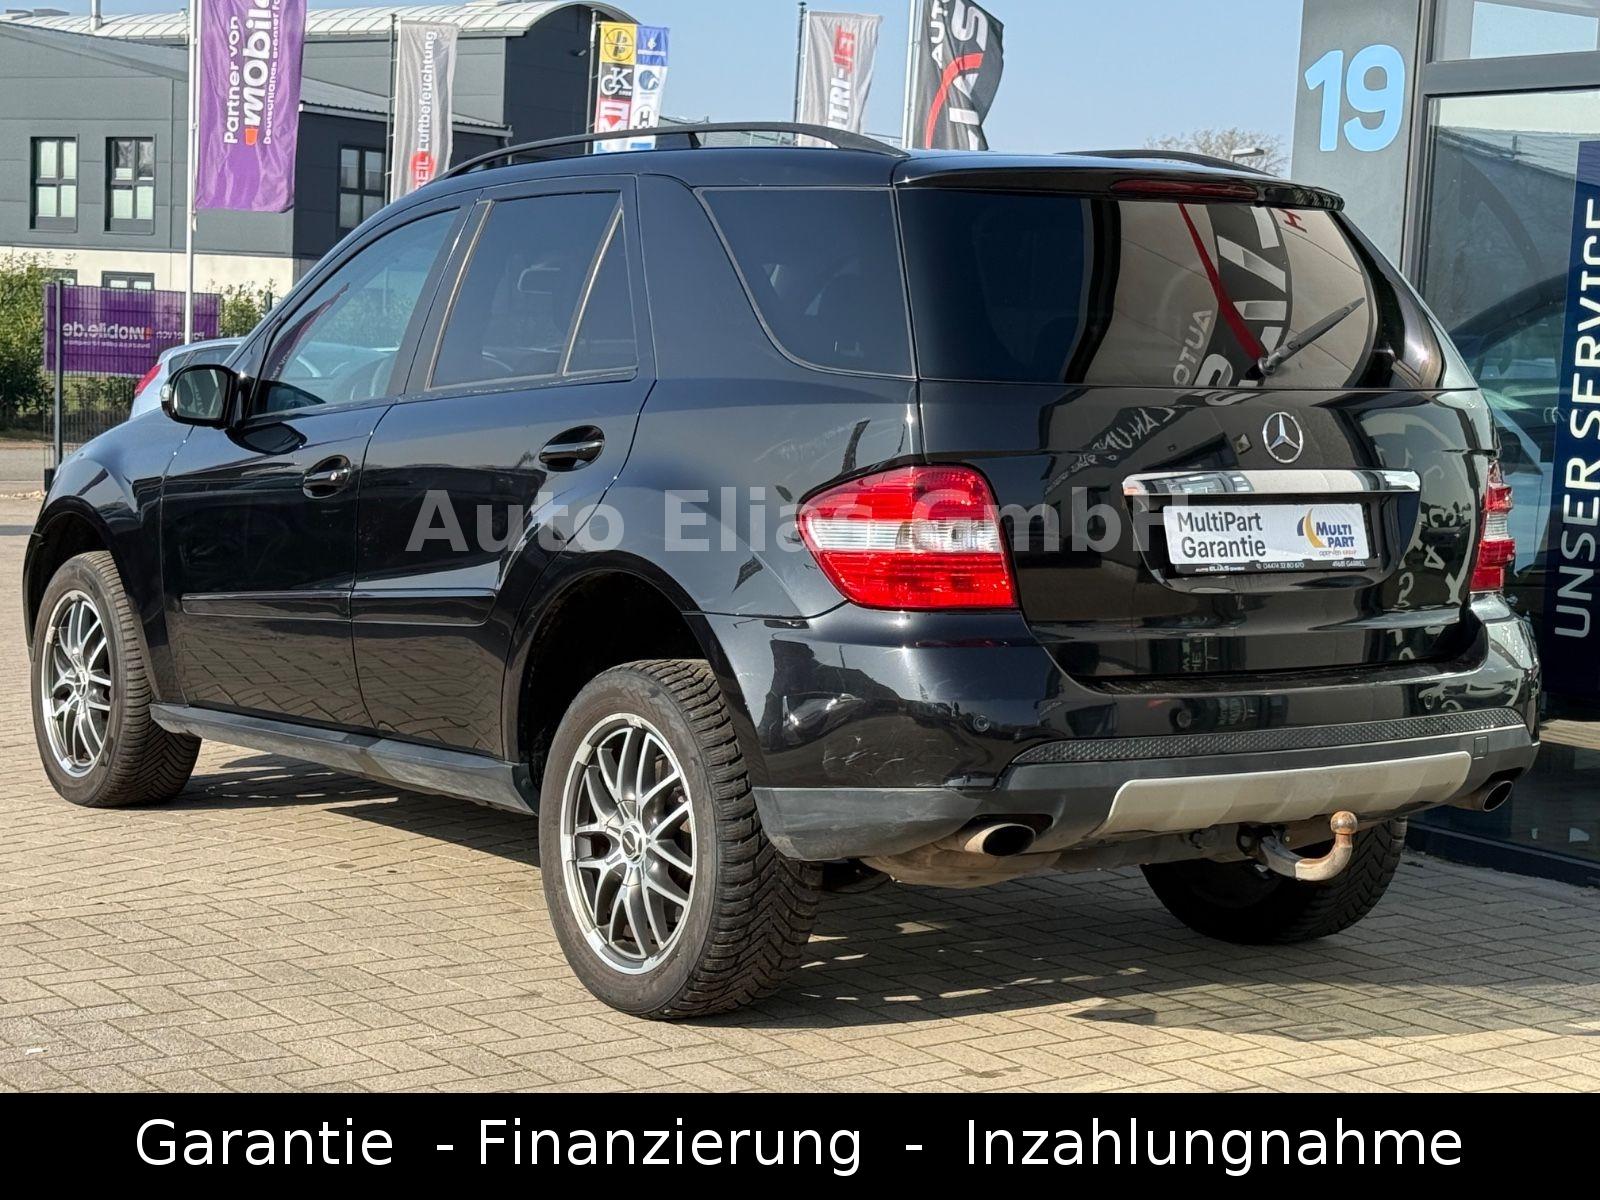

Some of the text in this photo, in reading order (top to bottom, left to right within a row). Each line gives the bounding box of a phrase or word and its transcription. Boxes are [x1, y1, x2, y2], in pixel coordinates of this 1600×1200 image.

[930, 0, 950, 70] AUT
[224, 16, 240, 144] Partner von
[416, 31, 438, 152] Luftbefeuchtung
[1304, 44, 1406, 152] 19
[1177, 511, 1263, 533] MultiPart
[1181, 535, 1267, 558] Garantie
[1327, 536, 1355, 548] PART
[1554, 456, 1600, 638] UNSER
